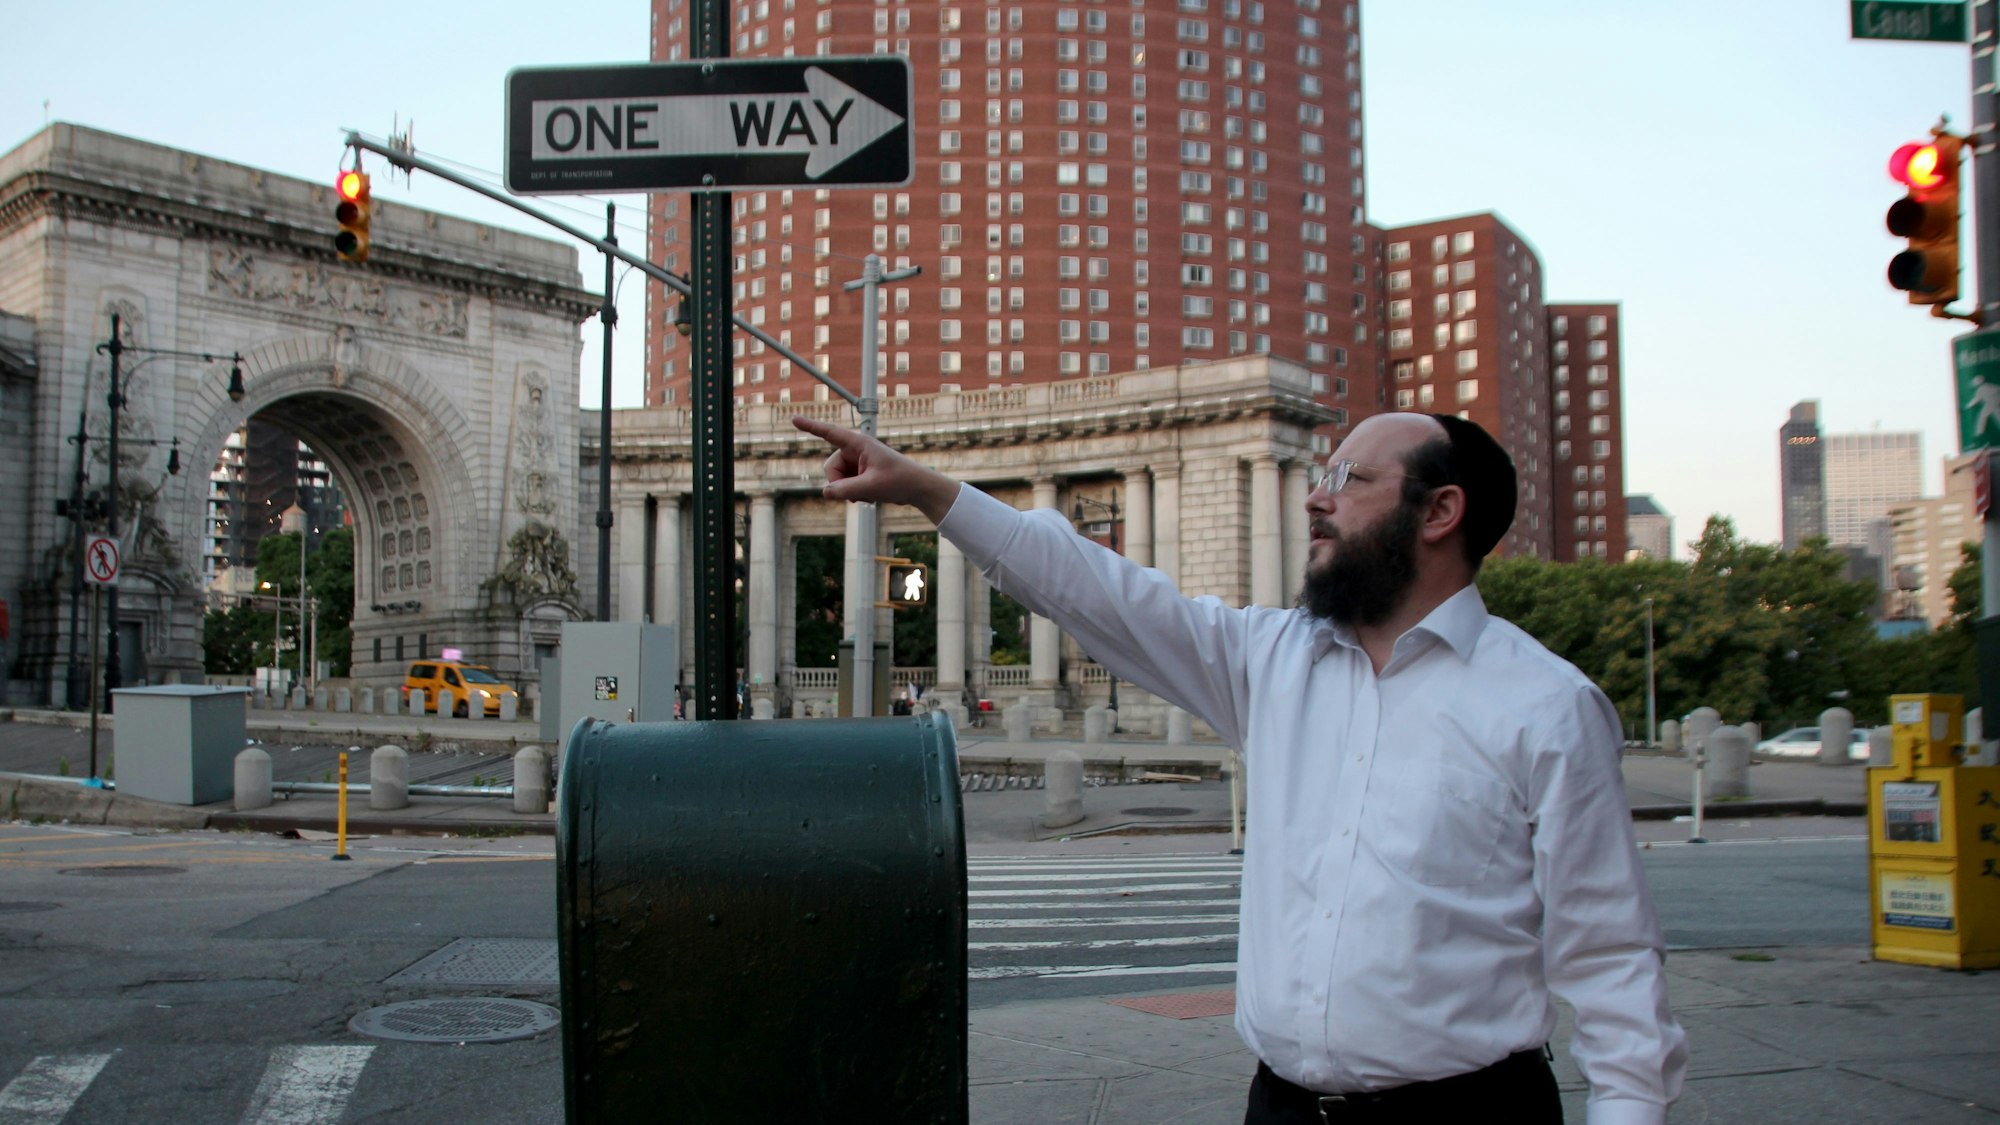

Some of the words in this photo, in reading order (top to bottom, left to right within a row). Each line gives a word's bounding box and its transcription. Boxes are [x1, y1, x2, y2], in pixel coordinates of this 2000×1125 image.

[1863, 2, 1930, 36] Canal
[545, 103, 659, 152] ONE
[729, 98, 855, 147] WAY
[561, 169, 613, 178] TRANSPORTATION
